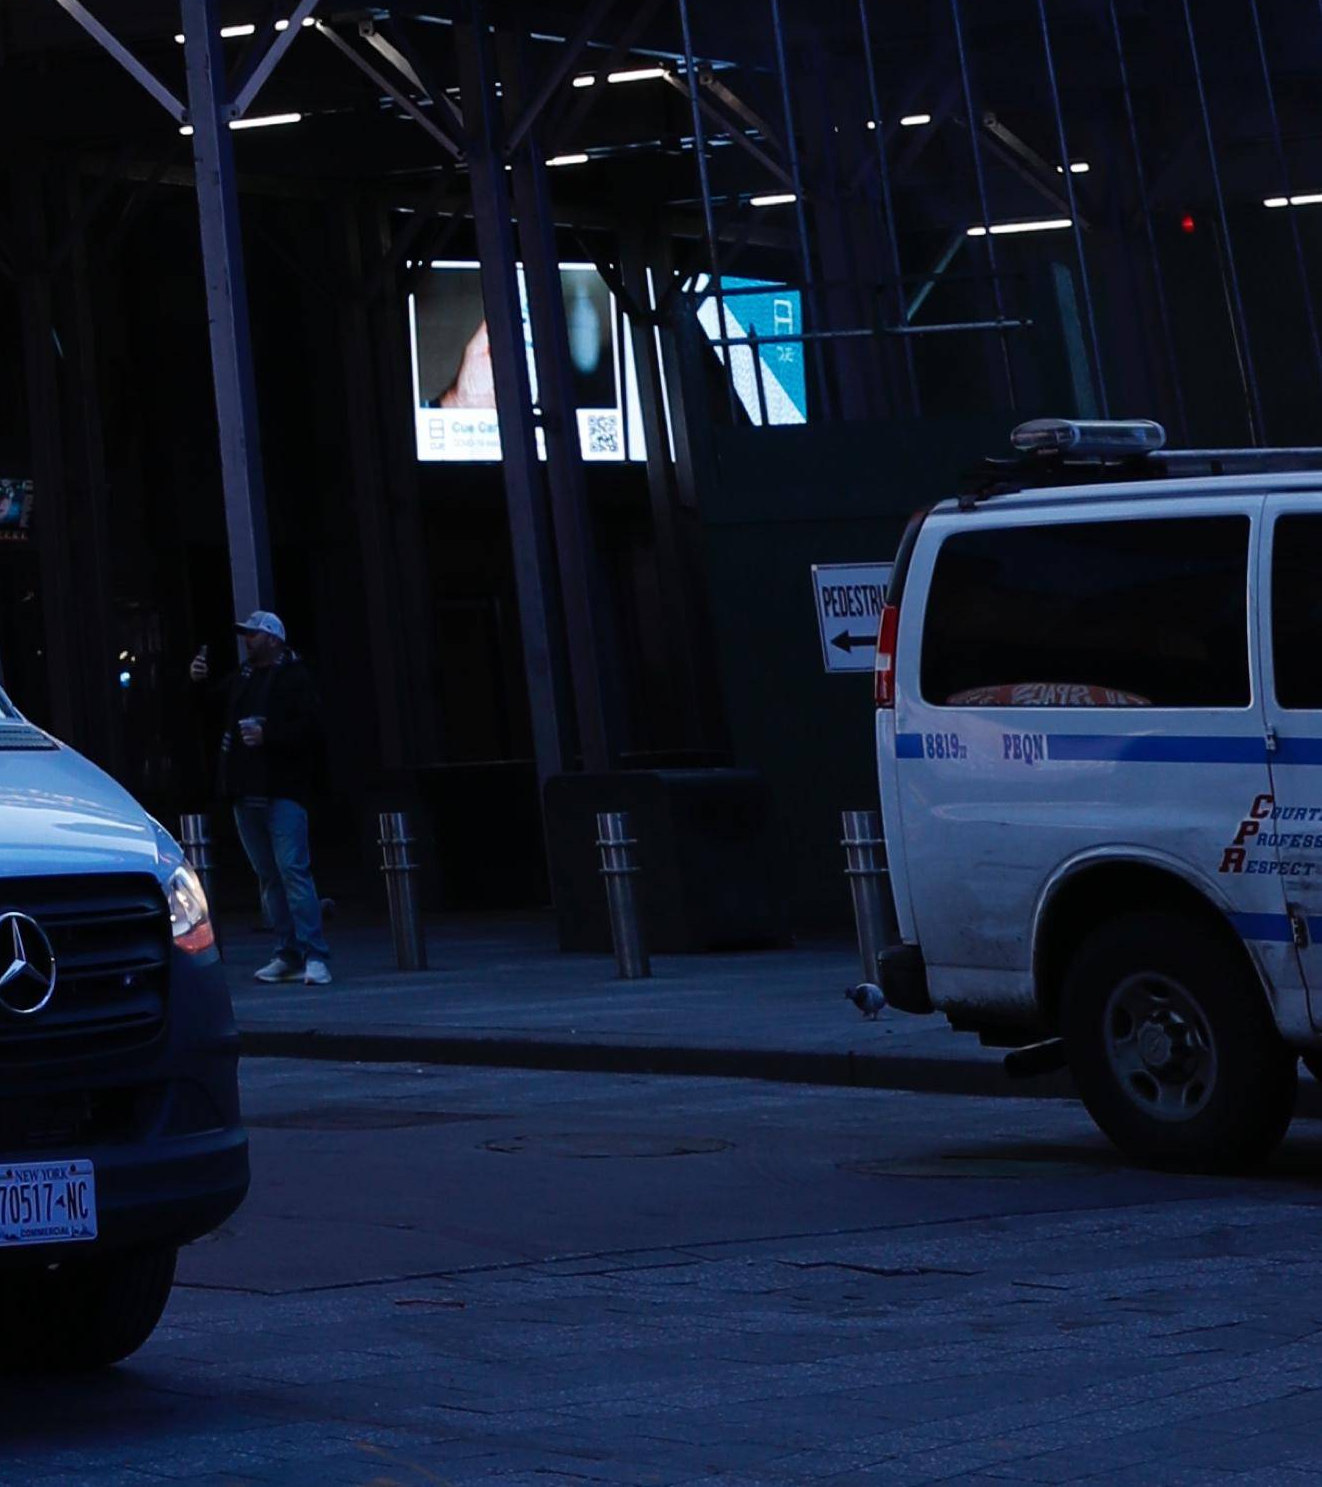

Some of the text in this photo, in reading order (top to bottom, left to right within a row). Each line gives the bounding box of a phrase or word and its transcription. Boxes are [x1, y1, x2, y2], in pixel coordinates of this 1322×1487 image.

[822, 585, 887, 617] PEDESTRI
[926, 734, 959, 759] 8819
[1003, 733, 1044, 765] PBQN
[1219, 848, 1315, 875] RESPECT
[15, 1167, 68, 1181] NEW YORK
